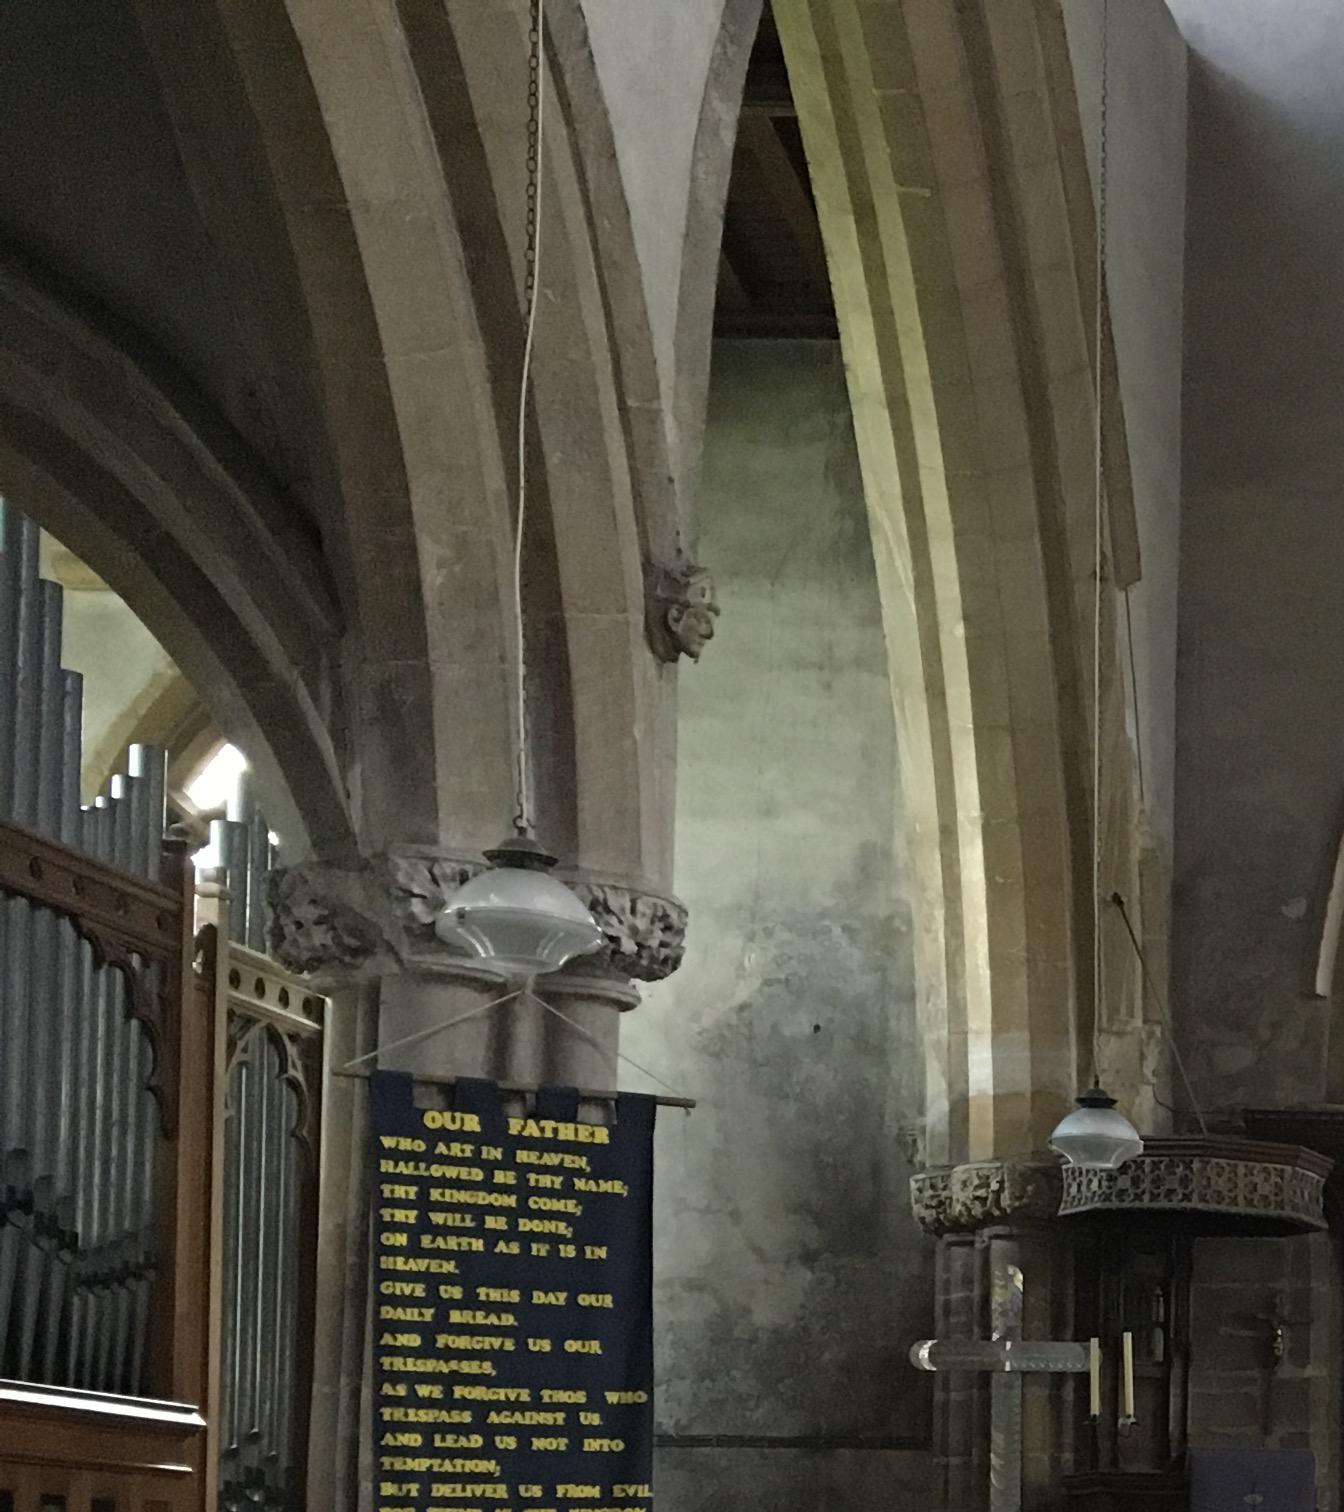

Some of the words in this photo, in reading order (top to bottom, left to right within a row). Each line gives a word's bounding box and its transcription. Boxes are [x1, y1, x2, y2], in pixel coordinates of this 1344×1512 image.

[423, 1110, 481, 1132] OUR
[507, 1118, 609, 1144] FATHER
[380, 1136, 426, 1152] WHO
[434, 1142, 474, 1158] ART
[480, 1146, 502, 1161] IN
[379, 1158, 484, 1181] HALLOWED
[492, 1170, 517, 1185] BE
[528, 1173, 563, 1189] THY
[381, 1184, 417, 1199] THY
[428, 1188, 517, 1207] KINGDOM
[380, 1208, 418, 1223] THY
[429, 1211, 475, 1228] WILL
[483, 1215, 508, 1230] BE
[381, 1231, 408, 1246] ON
[420, 1235, 484, 1252] EARTH
[494, 1240, 521, 1254] AS
[531, 1242, 550, 1256] IT
[559, 1244, 576, 1258] IS
[585, 1246, 608, 1259] IN
[380, 1280, 425, 1297] GIVE
[439, 1284, 463, 1300] US
[476, 1287, 521, 1303] THIS
[532, 1290, 568, 1305] DAY
[577, 1293, 614, 1308] OUR
[379, 1306, 436, 1322] DAILY
[380, 1333, 421, 1348] AND
[435, 1334, 515, 1351] FORGIVE
[527, 1338, 552, 1352] US
[564, 1339, 602, 1354] OUR
[380, 1382, 408, 1397] AS
[415, 1384, 444, 1399] WE
[452, 1385, 531, 1402] FORGIVE
[605, 1391, 648, 1406] WHO
[380, 1407, 472, 1424] TRESPASS
[486, 1411, 565, 1425] AGAINST
[381, 1432, 423, 1448] AND
[432, 1434, 485, 1450] LEAD
[495, 1436, 518, 1449] US
[531, 1437, 568, 1451] NOT
[582, 1437, 624, 1452] INTO
[379, 1481, 421, 1497] BUT
[432, 1484, 509, 1499] DELIVER
[518, 1485, 543, 1498] US
[556, 1484, 601, 1499] FROM
